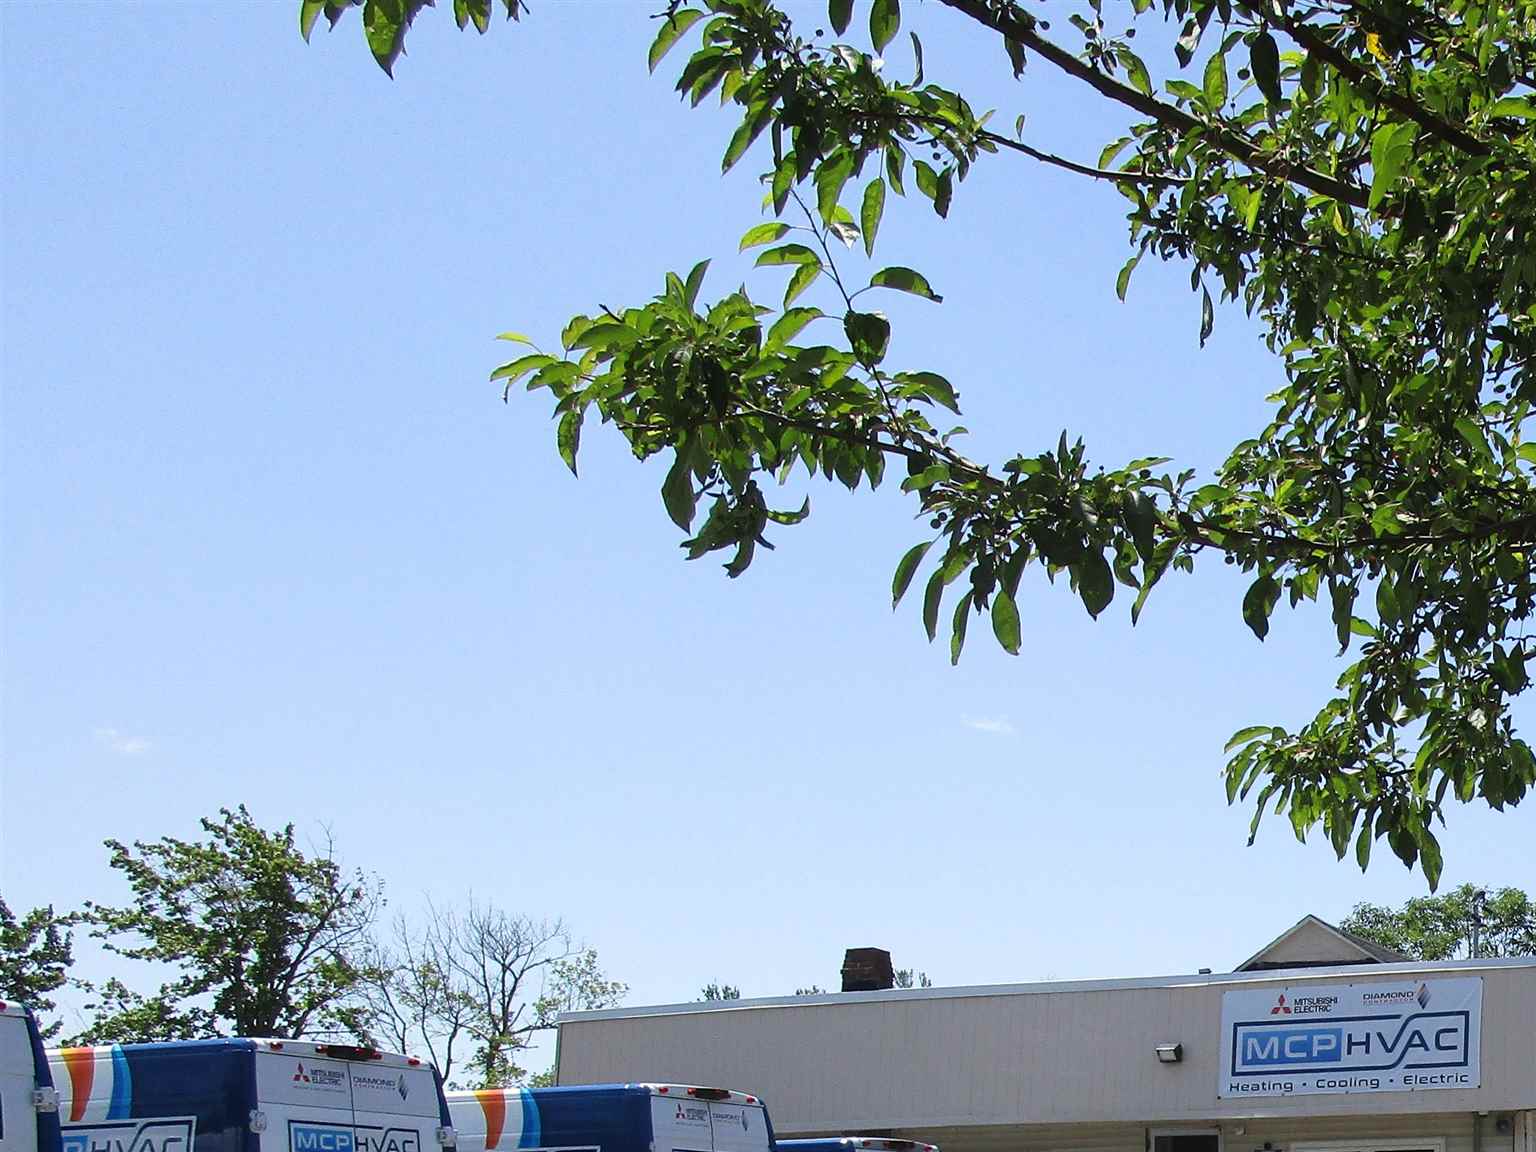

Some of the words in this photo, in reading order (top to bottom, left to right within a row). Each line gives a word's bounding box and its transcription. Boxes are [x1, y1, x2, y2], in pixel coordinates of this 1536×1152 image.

[1294, 996, 1338, 1006] MITSUBISHI
[1363, 991, 1414, 1000] DIAMOND
[1294, 1005, 1332, 1014] ELECTRIC
[1246, 1034, 1337, 1061] MCP
[1346, 1028, 1458, 1055] HVAC
[1230, 1080, 1293, 1093] Heating
[1316, 1077, 1380, 1090] Cooling
[1403, 1072, 1469, 1085] Electric
[297, 1131, 350, 1151] MCP
